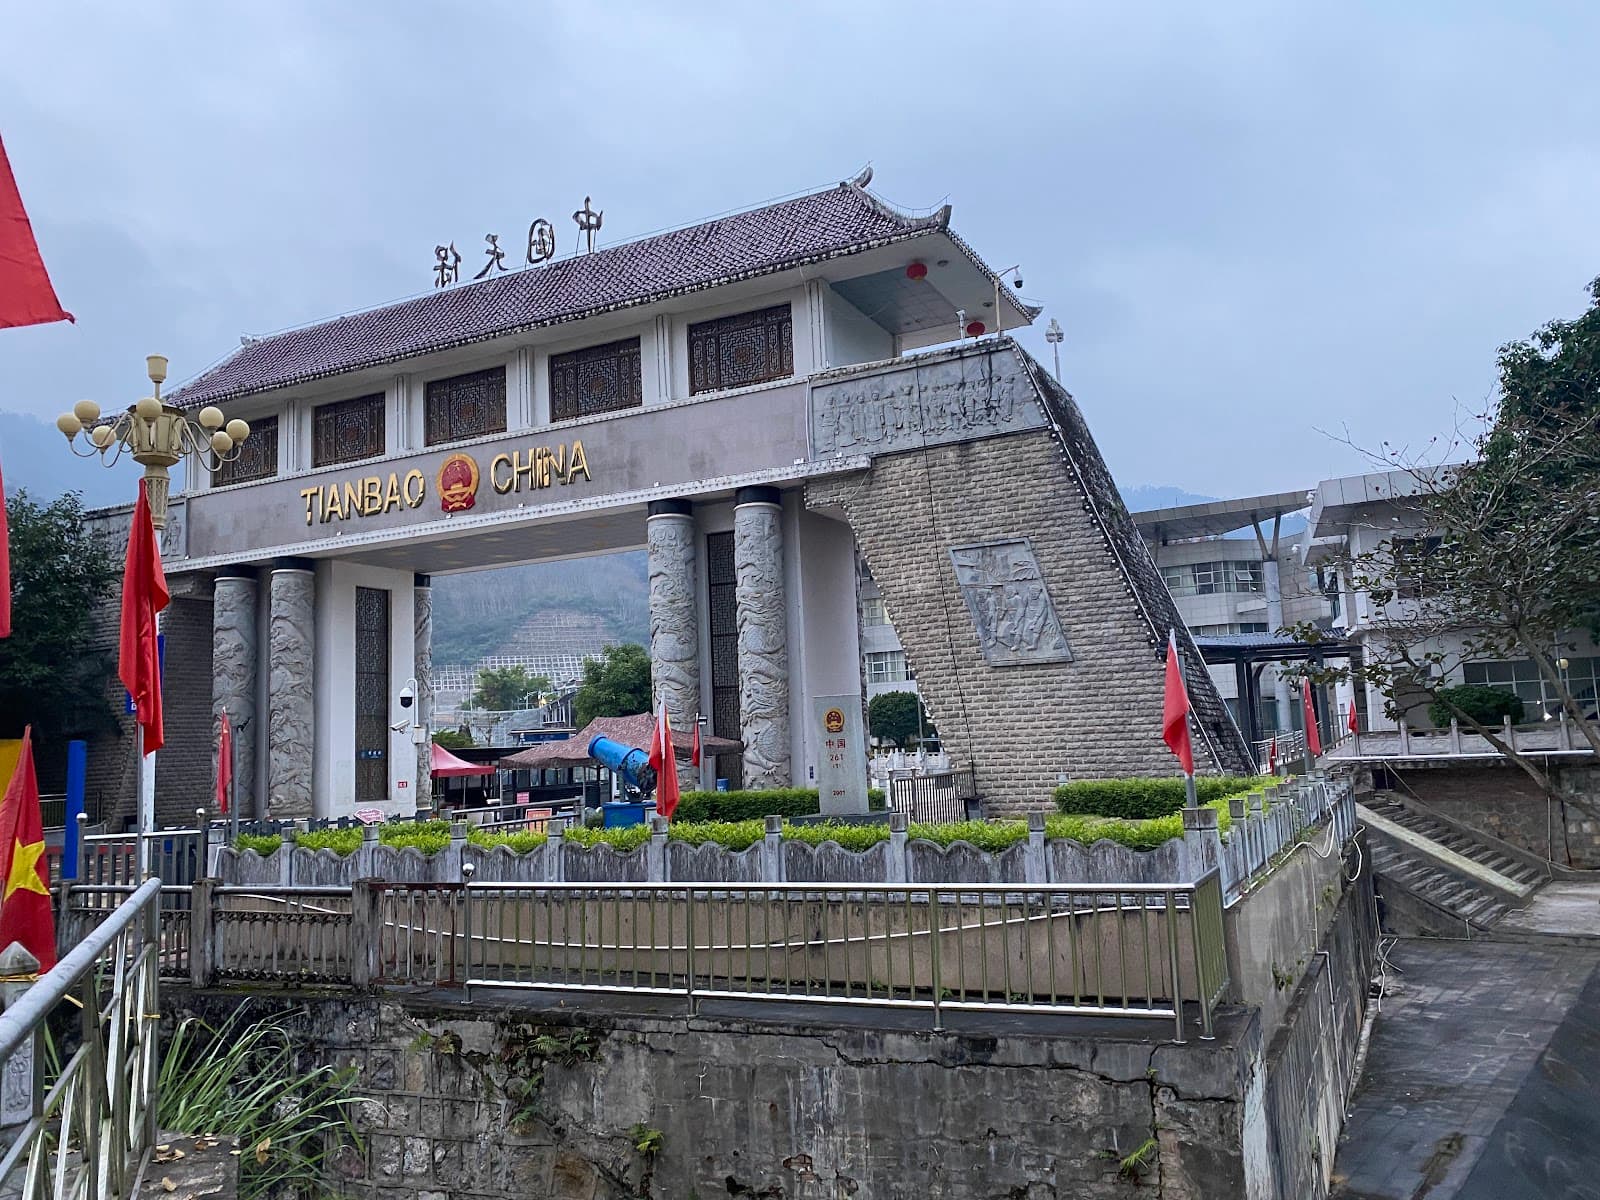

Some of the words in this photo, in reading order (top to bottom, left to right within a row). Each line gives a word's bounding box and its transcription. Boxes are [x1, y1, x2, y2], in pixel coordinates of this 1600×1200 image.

[300, 468, 426, 526] TIANBAO
[490, 439, 592, 495] CHINA
[825, 738, 846, 749] 中国
